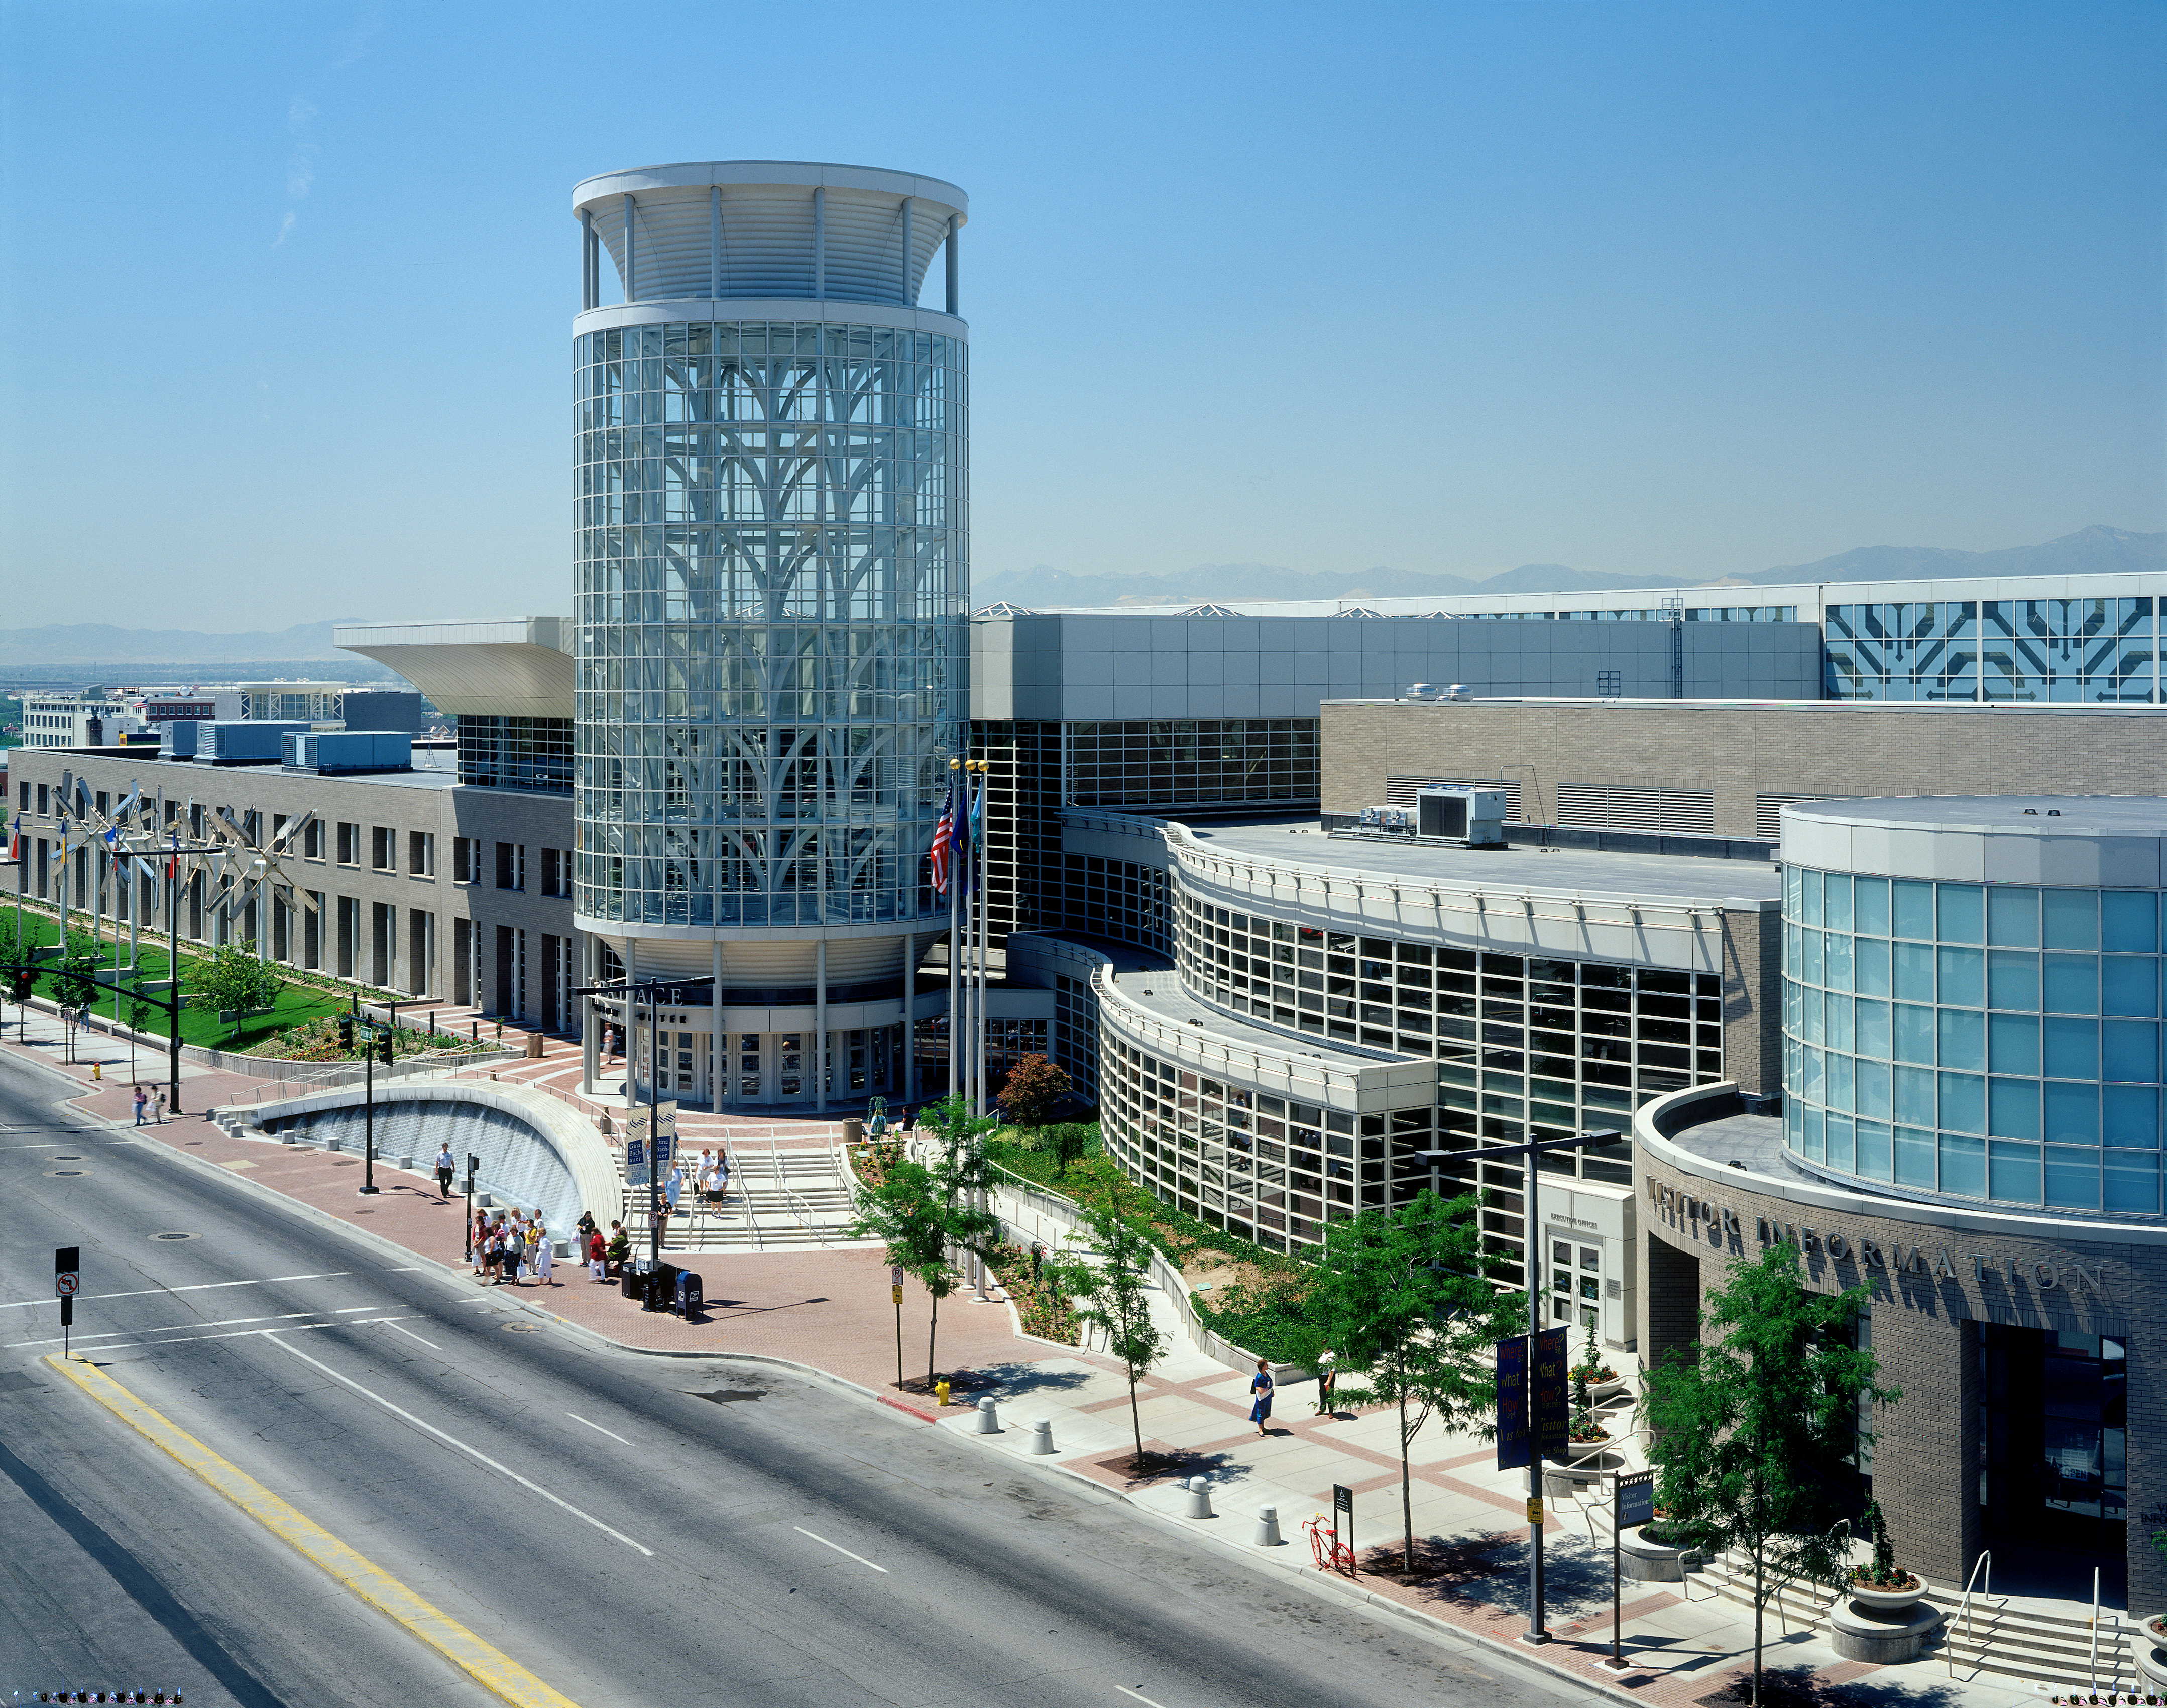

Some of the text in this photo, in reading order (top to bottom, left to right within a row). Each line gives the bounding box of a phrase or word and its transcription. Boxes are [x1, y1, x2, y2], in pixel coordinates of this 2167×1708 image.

[1645, 1174, 2104, 1294] VISITOR INFORMATION
[2062, 1466, 2087, 1479] OPEN
[1621, 1492, 1637, 1500] Visitor
[1622, 1499, 1649, 1510] Information
